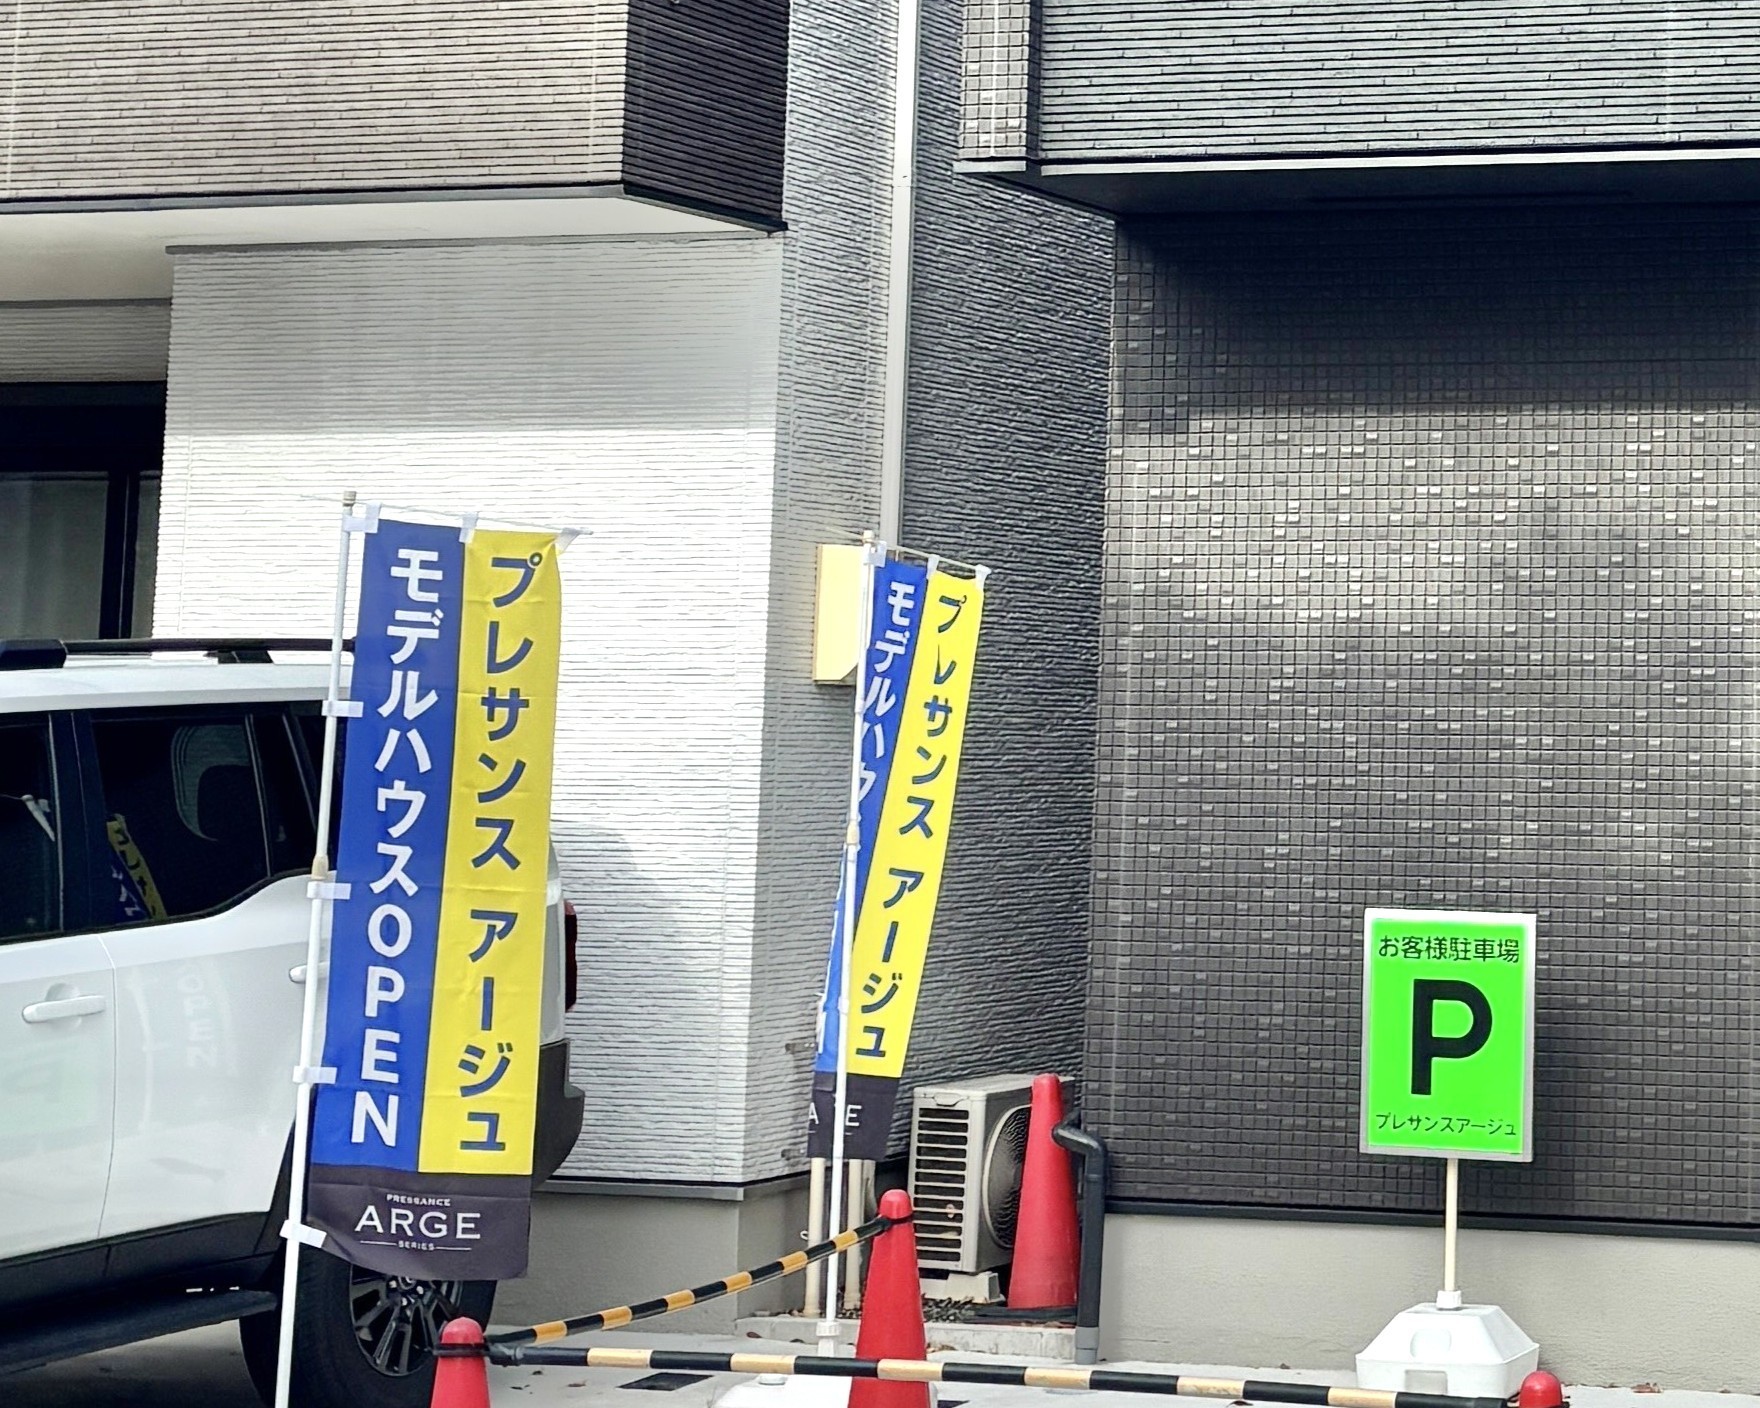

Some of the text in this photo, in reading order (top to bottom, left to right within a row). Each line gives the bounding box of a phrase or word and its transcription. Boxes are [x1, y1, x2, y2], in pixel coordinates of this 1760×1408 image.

[855, 594, 967, 1058] プレサンス アージュ
[457, 551, 543, 1151] プレサンス アージュ
[1379, 935, 1520, 963] お客様駐車場
[1411, 978, 1493, 1095] P
[1376, 1112, 1517, 1136] プレサンスアージュ
[386, 1194, 451, 1206] PRESSANCE
[354, 1205, 481, 1240] ARGE
[398, 1240, 435, 1251] SERIES
